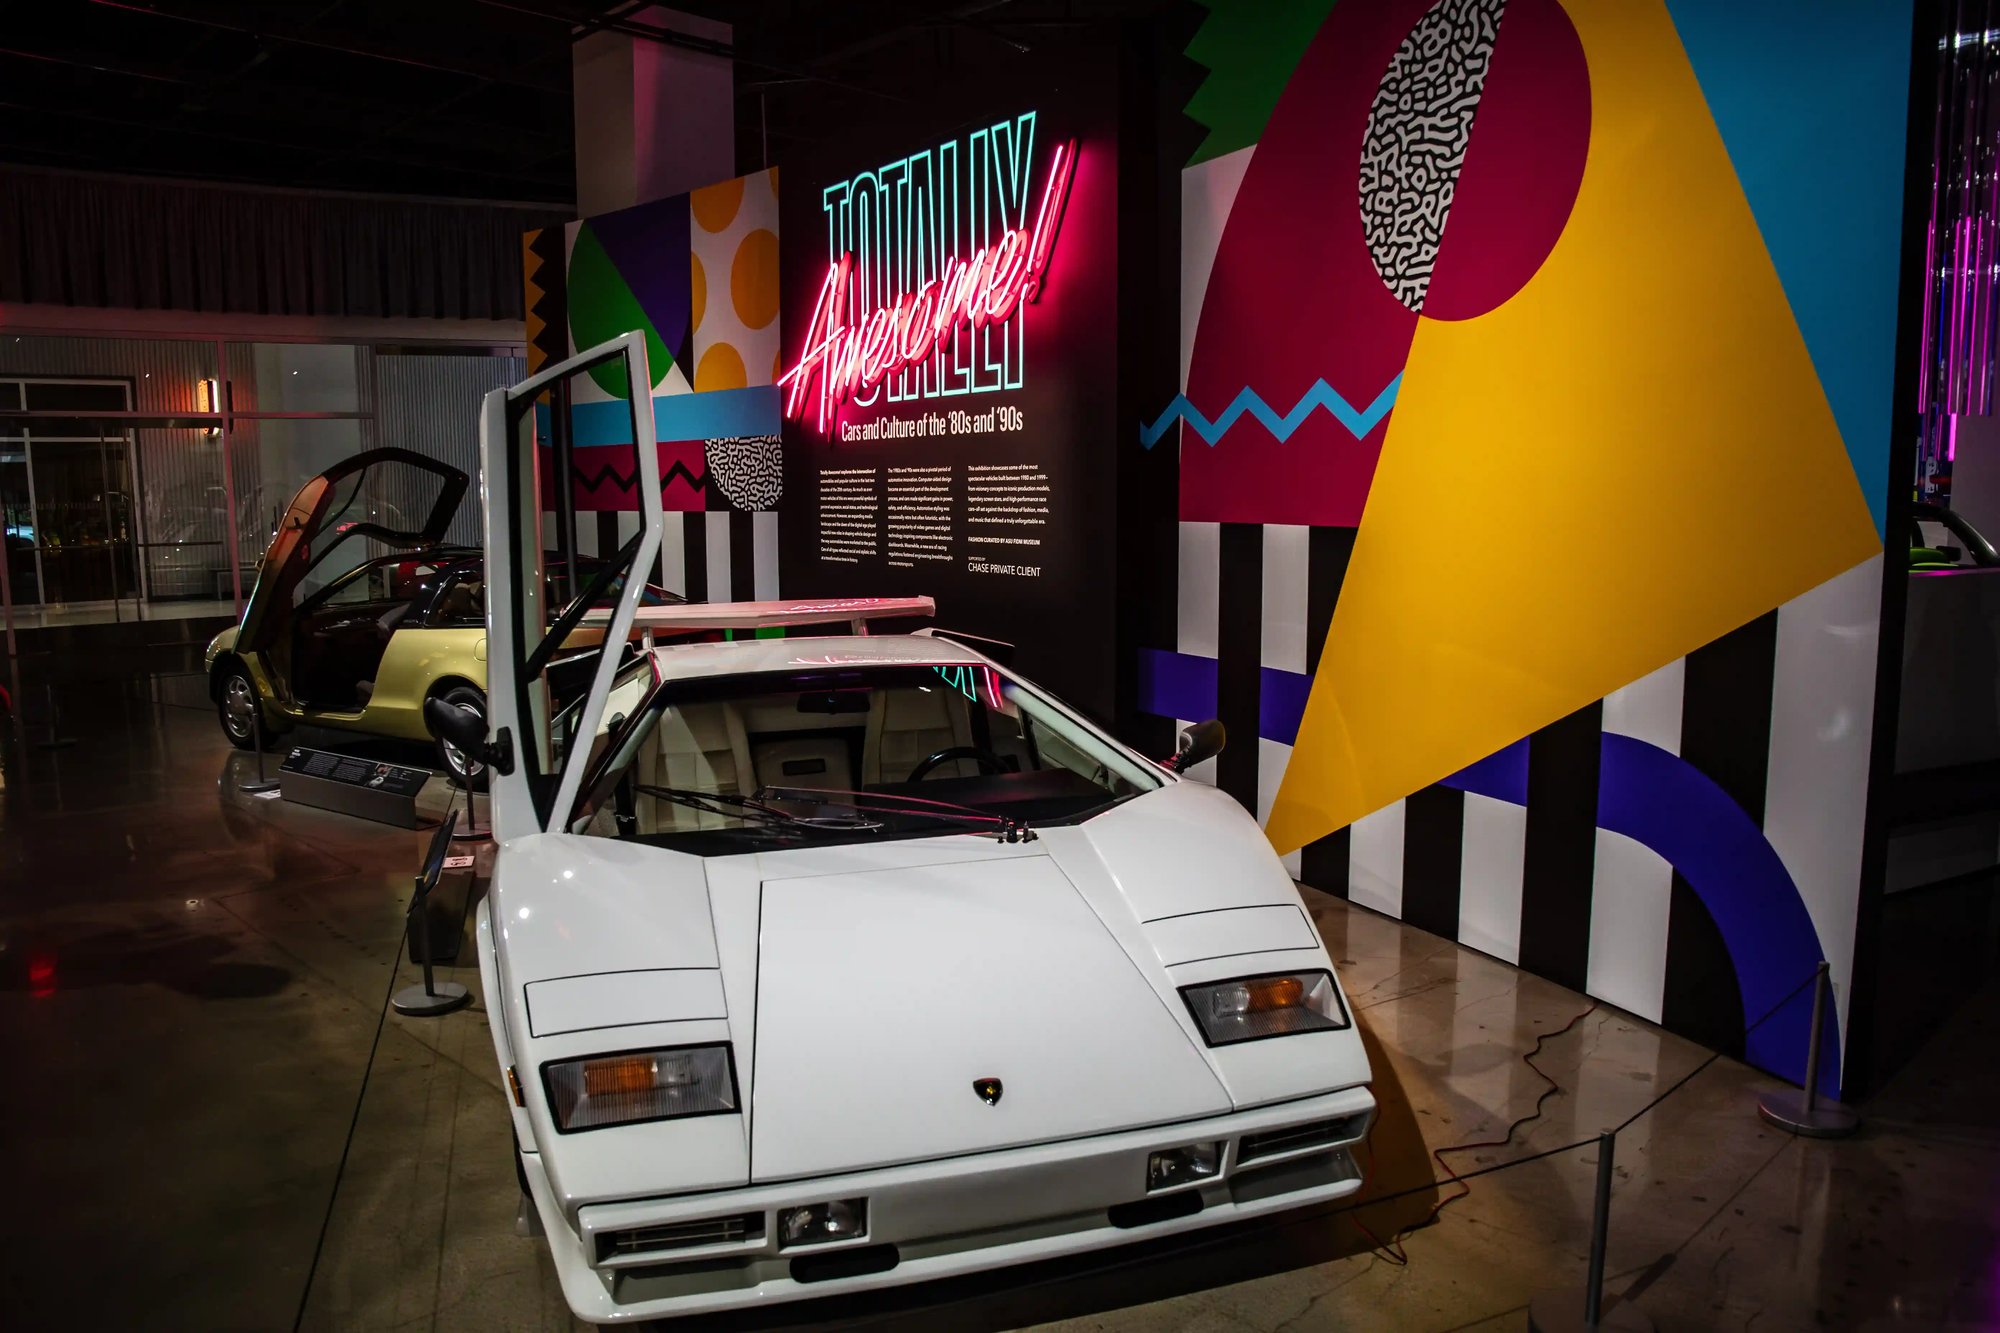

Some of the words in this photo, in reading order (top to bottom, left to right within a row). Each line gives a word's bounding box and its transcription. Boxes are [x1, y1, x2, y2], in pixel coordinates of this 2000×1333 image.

[778, 141, 1072, 436] Awesome!
[823, 111, 1036, 406] TOTALLY
[841, 421, 861, 442] Cars
[862, 417, 880, 440] and
[880, 416, 915, 439] Culture
[916, 413, 928, 437] of
[928, 412, 946, 436] the
[973, 407, 995, 434] and
[968, 562, 989, 573] CHASE
[990, 564, 1016, 575] PRIVATE
[1017, 566, 1041, 577] CLIENT
